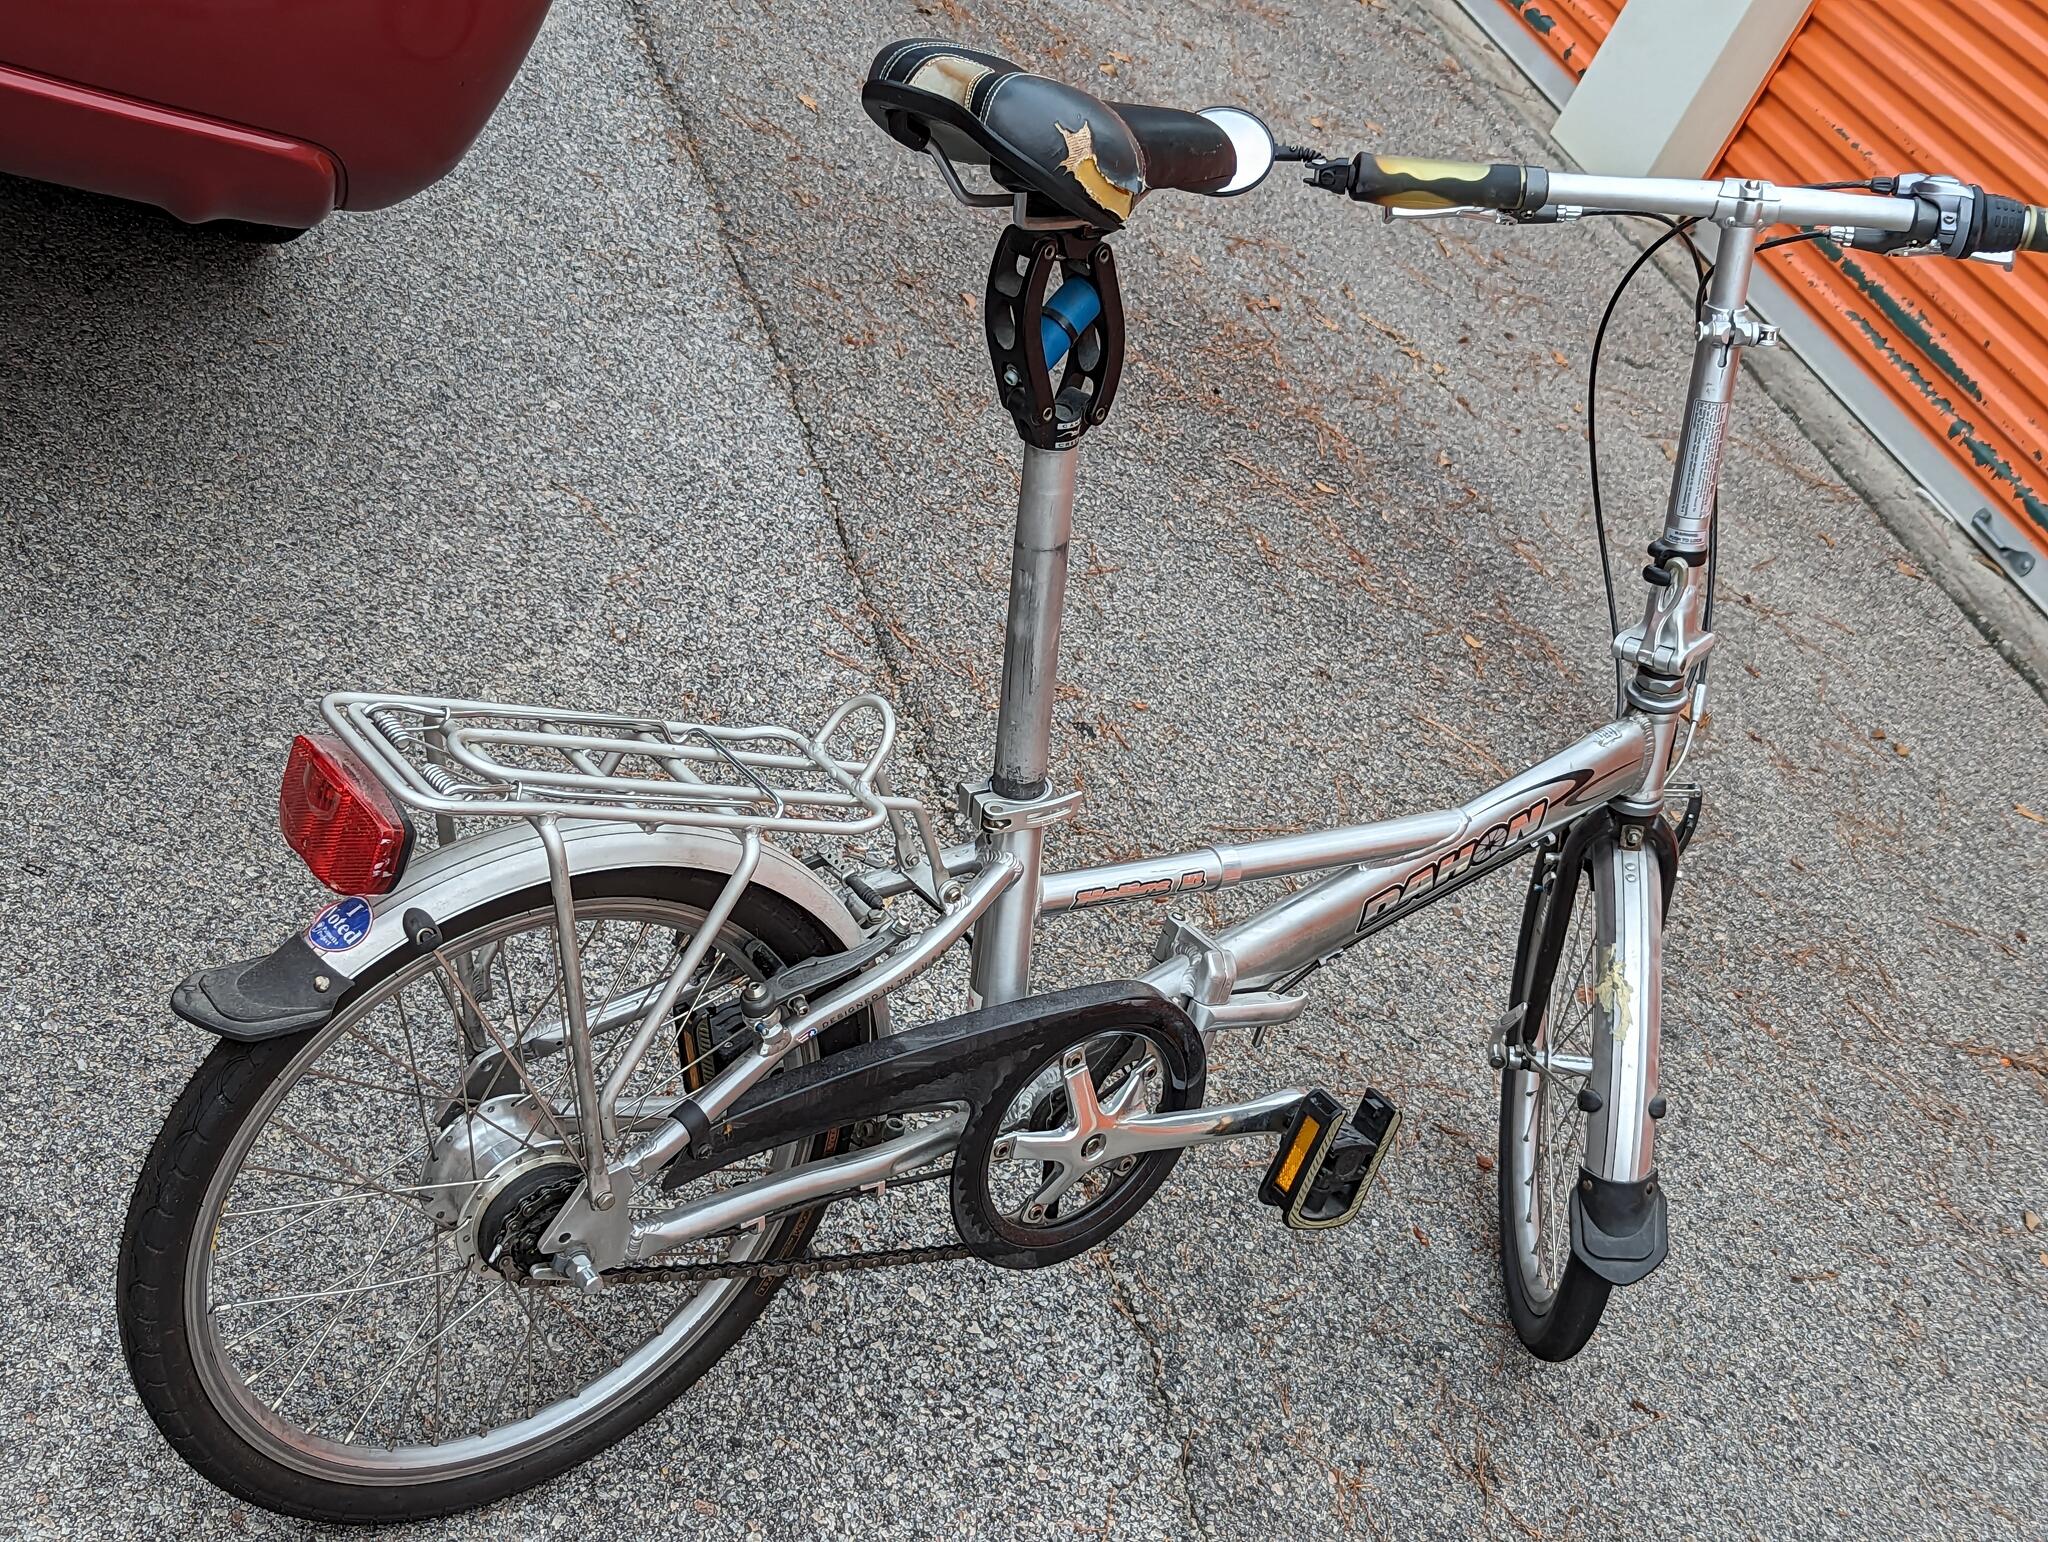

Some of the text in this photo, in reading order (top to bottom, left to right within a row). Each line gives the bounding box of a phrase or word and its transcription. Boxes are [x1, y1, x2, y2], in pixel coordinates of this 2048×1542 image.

[1356, 798, 1549, 933] DAHON
[325, 907, 362, 945] Voted
[346, 903, 364, 917] I
[822, 993, 878, 1029] DESIGNED
[882, 984, 894, 996] IN
[897, 969, 918, 985] THE
